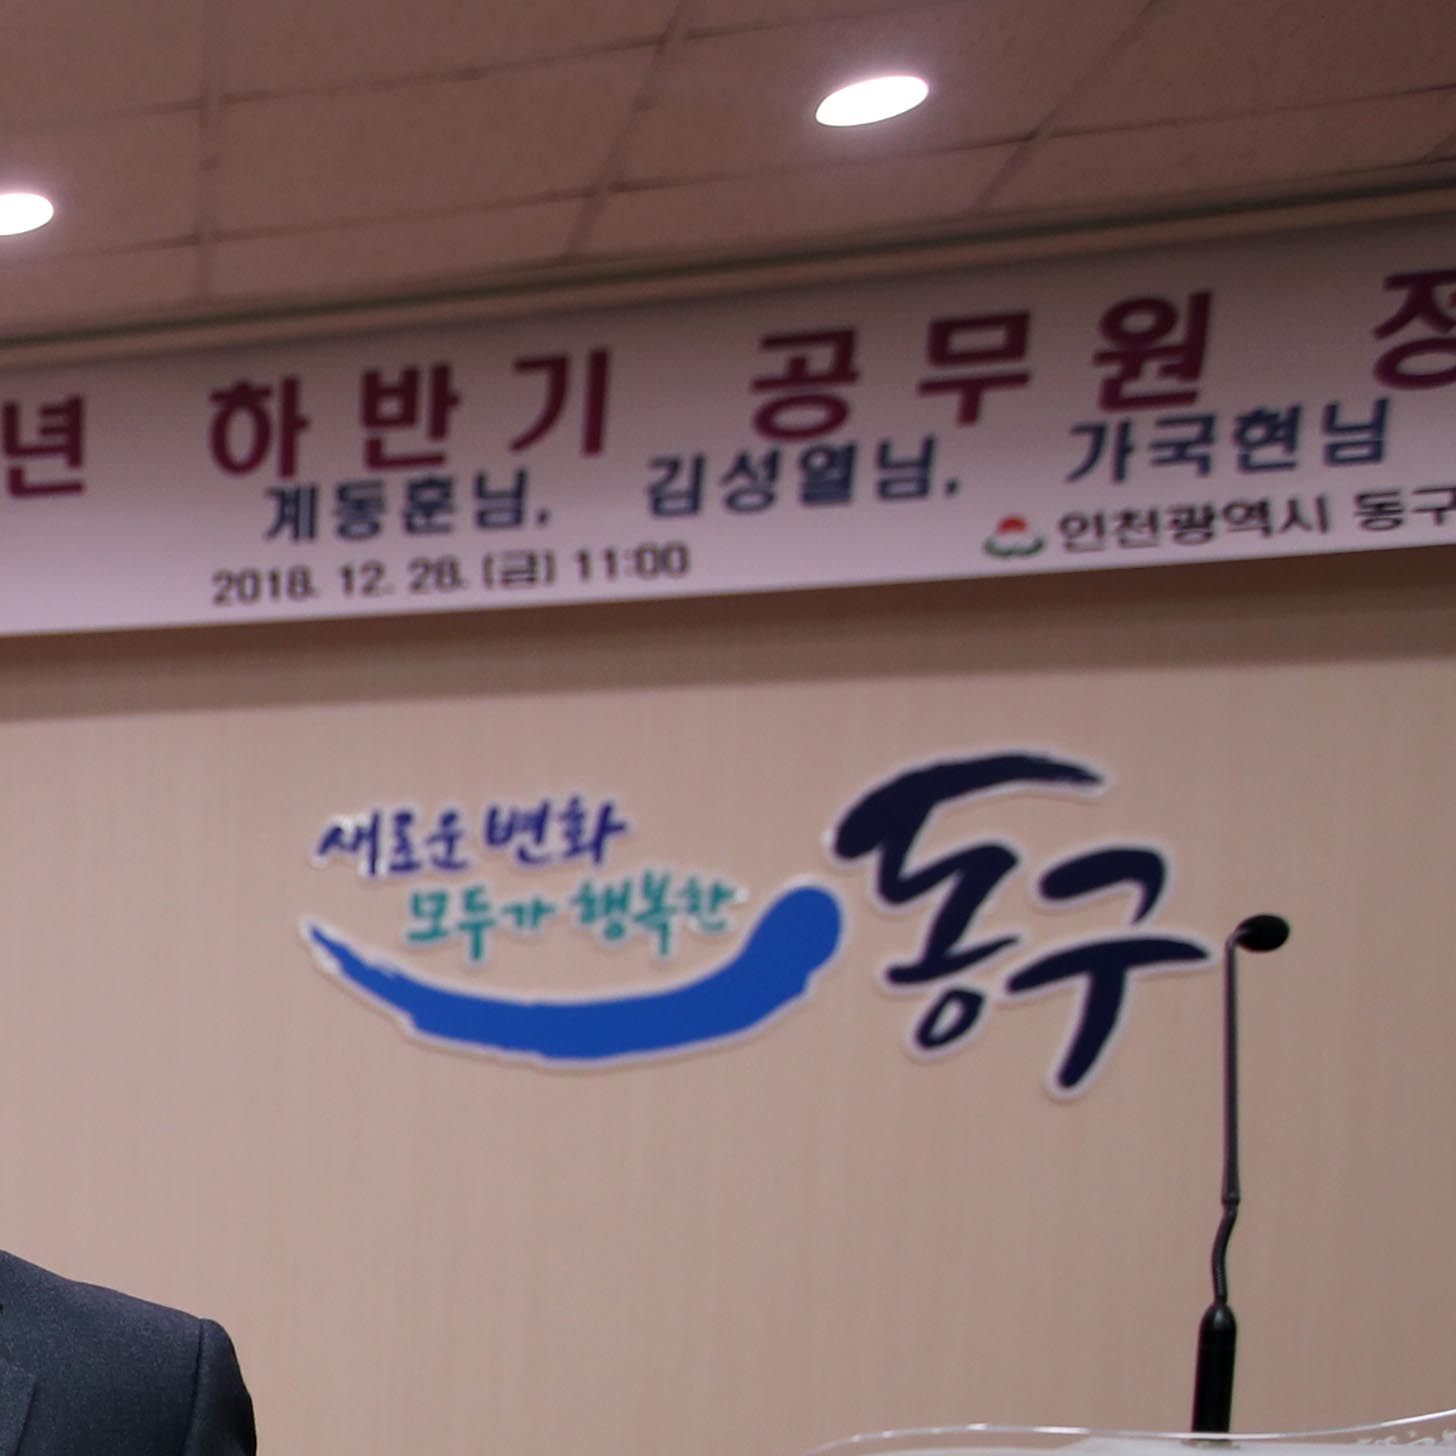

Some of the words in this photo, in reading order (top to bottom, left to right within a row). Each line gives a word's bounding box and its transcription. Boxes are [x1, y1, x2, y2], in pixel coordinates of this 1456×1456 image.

[207, 345, 612, 480] 하반기
[751, 290, 1212, 441] 공무원
[1065, 396, 1390, 485] 가국현님
[574, 541, 691, 582] 11:00
[1058, 494, 1330, 553] 인천광역시
[316, 811, 466, 876] 새로운
[484, 794, 628, 870] 변화
[406, 883, 555, 960] 모두가
[570, 870, 738, 957] 행복한
[833, 752, 1211, 1090] 동구
